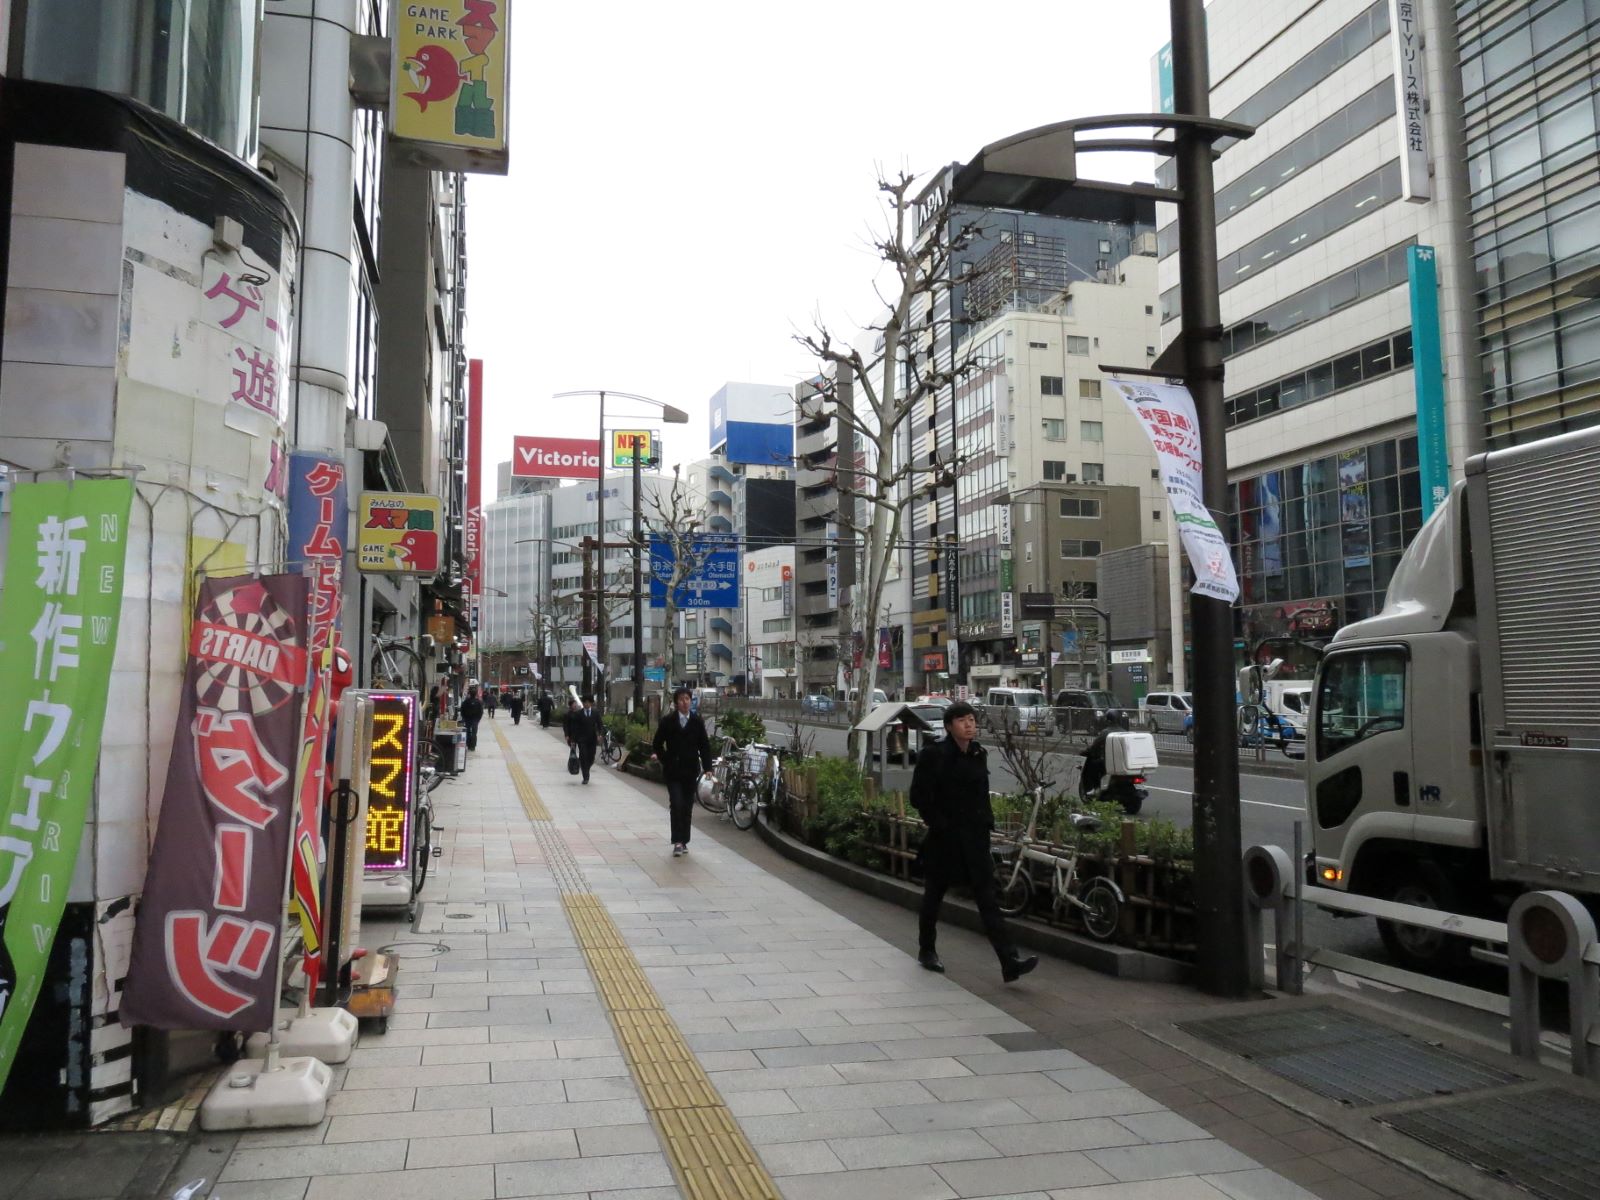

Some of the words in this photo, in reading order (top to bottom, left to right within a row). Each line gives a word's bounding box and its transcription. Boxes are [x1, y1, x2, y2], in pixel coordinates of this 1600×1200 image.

[408, 5, 449, 22] GAME
[416, 23, 457, 41] PARK
[1400, 0, 1424, 152] 京TYリース株式会社
[518, 446, 600, 467] Victoria
[362, 545, 385, 553] GAME
[362, 555, 385, 564] PARK
[707, 560, 736, 572] 大手町
[91, 514, 118, 645] NEW
[688, 598, 711, 606] 300m
[365, 714, 404, 852] スマ館
